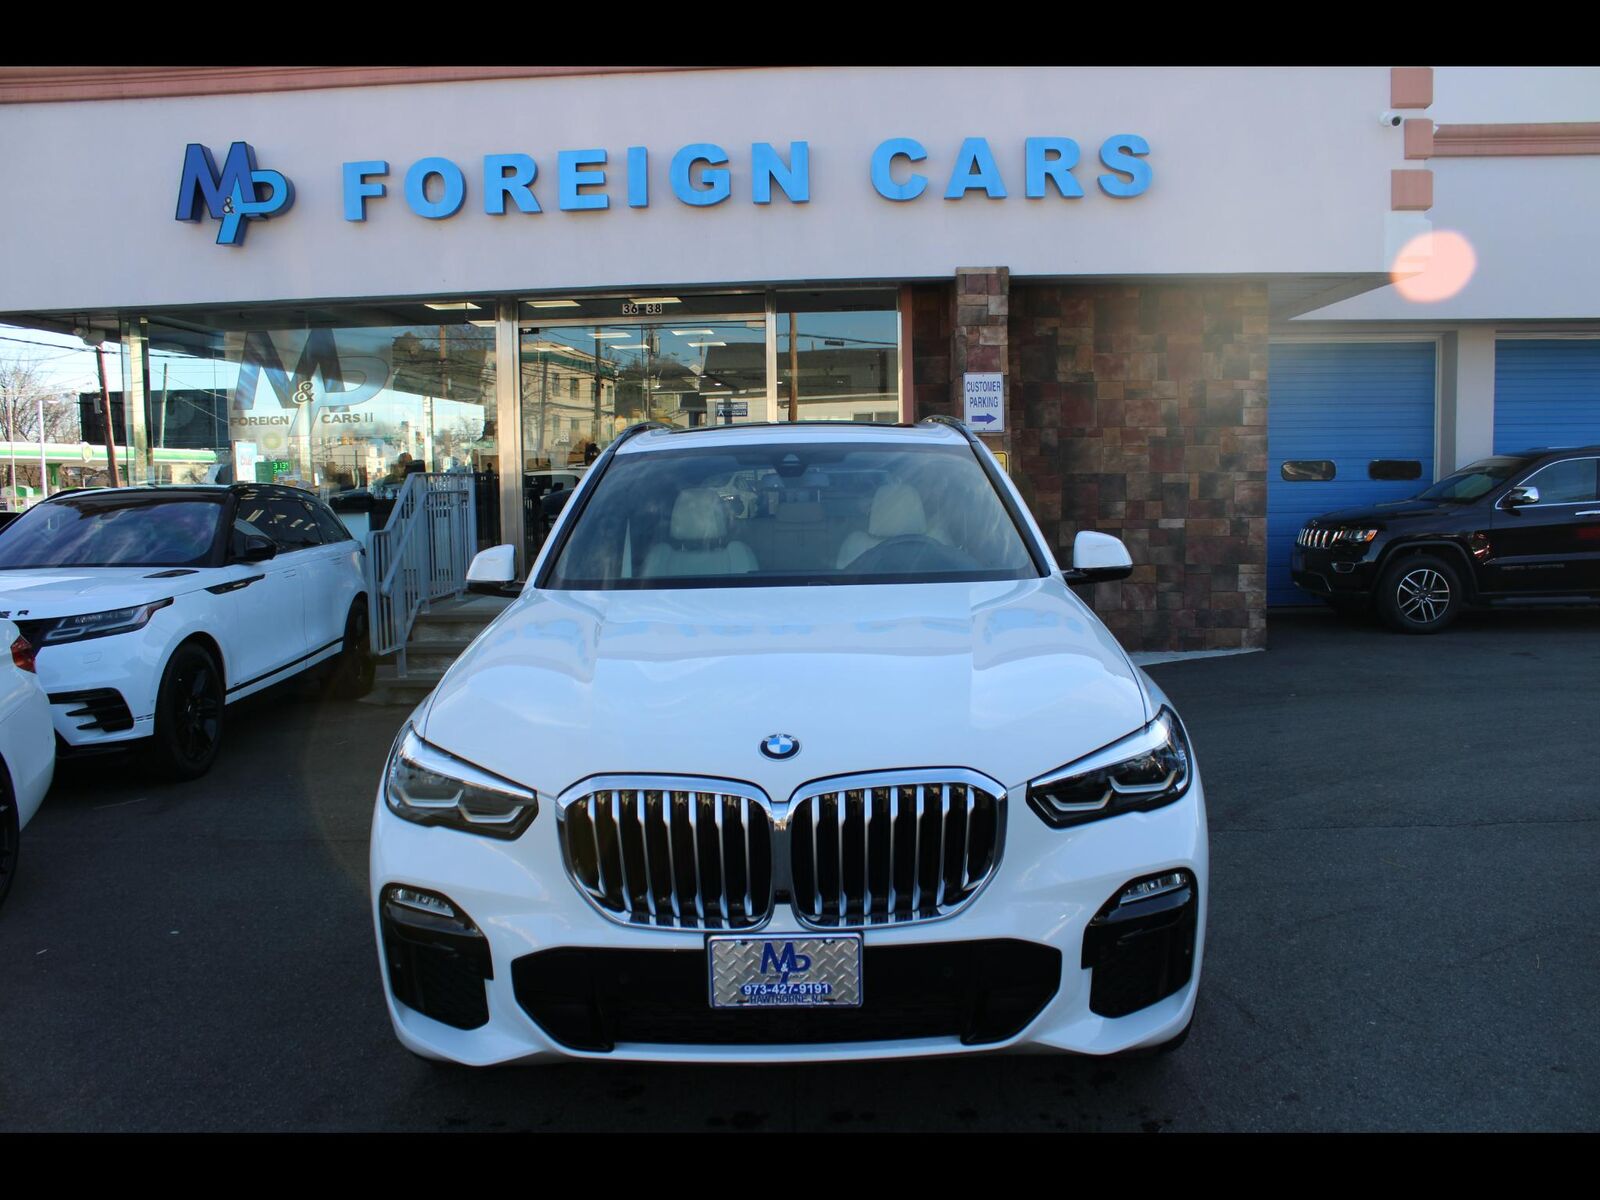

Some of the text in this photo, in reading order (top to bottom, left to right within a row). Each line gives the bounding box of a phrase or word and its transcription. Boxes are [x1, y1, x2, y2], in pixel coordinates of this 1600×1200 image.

[343, 133, 1153, 221] FOREIGN CARS
[966, 381, 1000, 392] CUSTOMER
[970, 397, 998, 408] PARKING
[230, 416, 289, 426] FOREIGN
[321, 413, 360, 424] CARS
[744, 984, 829, 995] 973-427-9191
